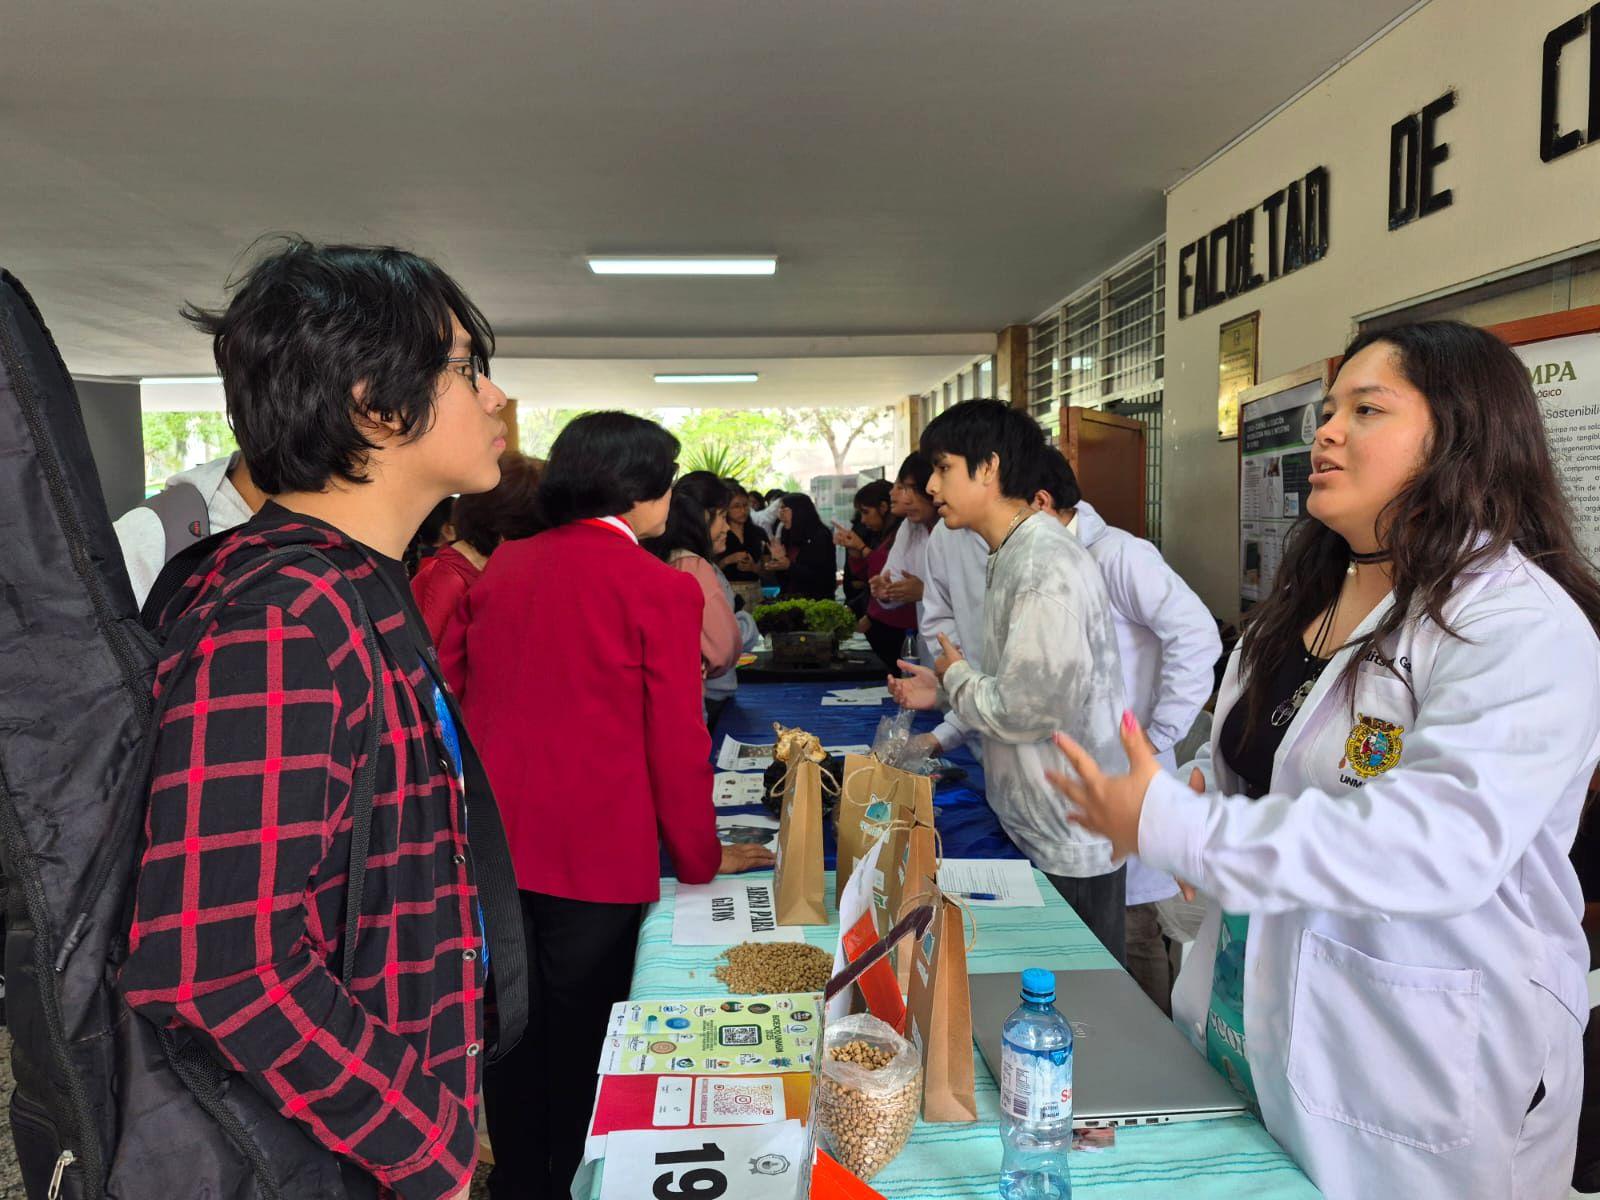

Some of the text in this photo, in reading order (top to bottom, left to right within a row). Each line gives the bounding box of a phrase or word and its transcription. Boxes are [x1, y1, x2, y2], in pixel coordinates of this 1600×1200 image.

[1178, 165, 1329, 320] FACULTAD
[1388, 91, 1457, 232] DE
[1545, 404, 1600, 419] Sostenibili
[1577, 433, 1600, 442] tangibl
[1339, 774, 1366, 789] UNM
[711, 896, 736, 922] GATOS
[746, 886, 775, 933] ARENA PARA
[653, 1143, 727, 1200] 19
